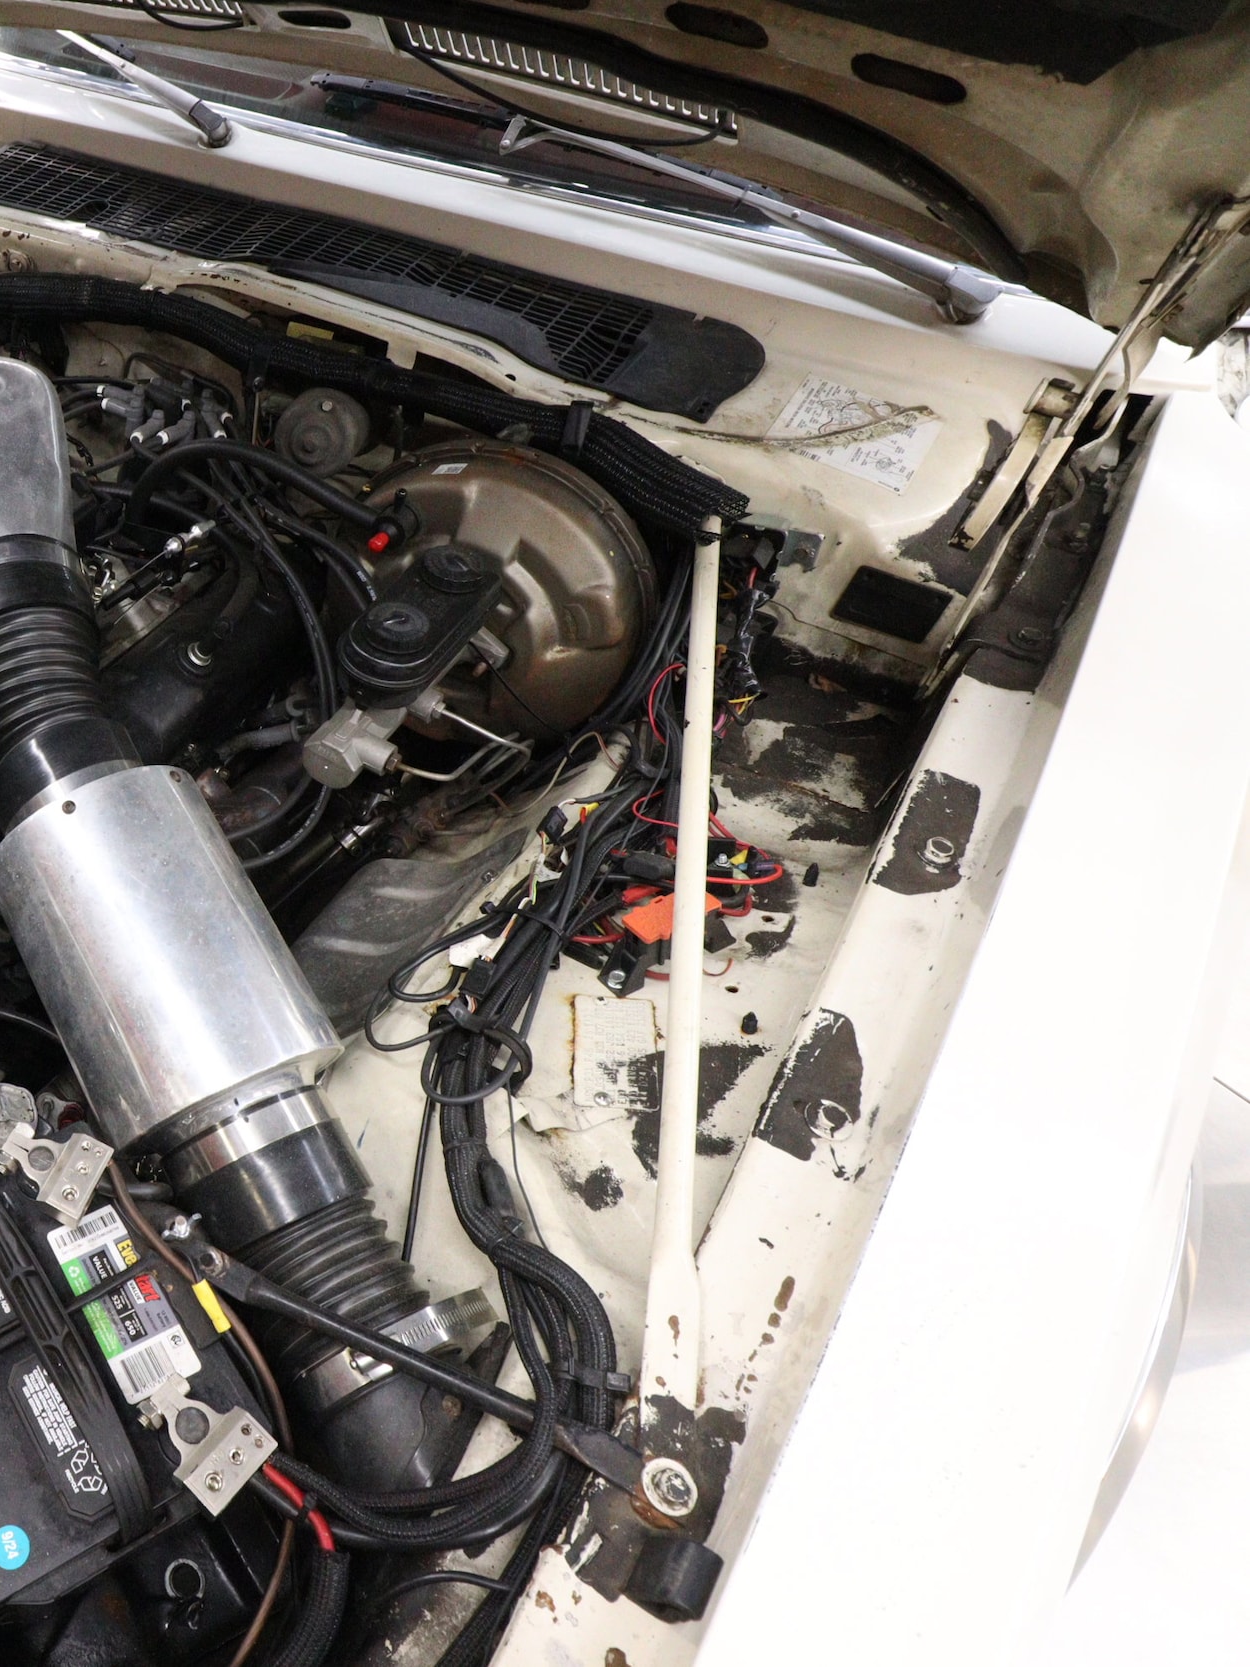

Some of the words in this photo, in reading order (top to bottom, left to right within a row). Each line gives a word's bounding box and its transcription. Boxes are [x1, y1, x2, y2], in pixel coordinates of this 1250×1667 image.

[128, 1281, 142, 1302] VALUE
[111, 1294, 123, 1310] 525
[124, 1320, 136, 1336] 650
[0, 1531, 18, 1560] 9/24
